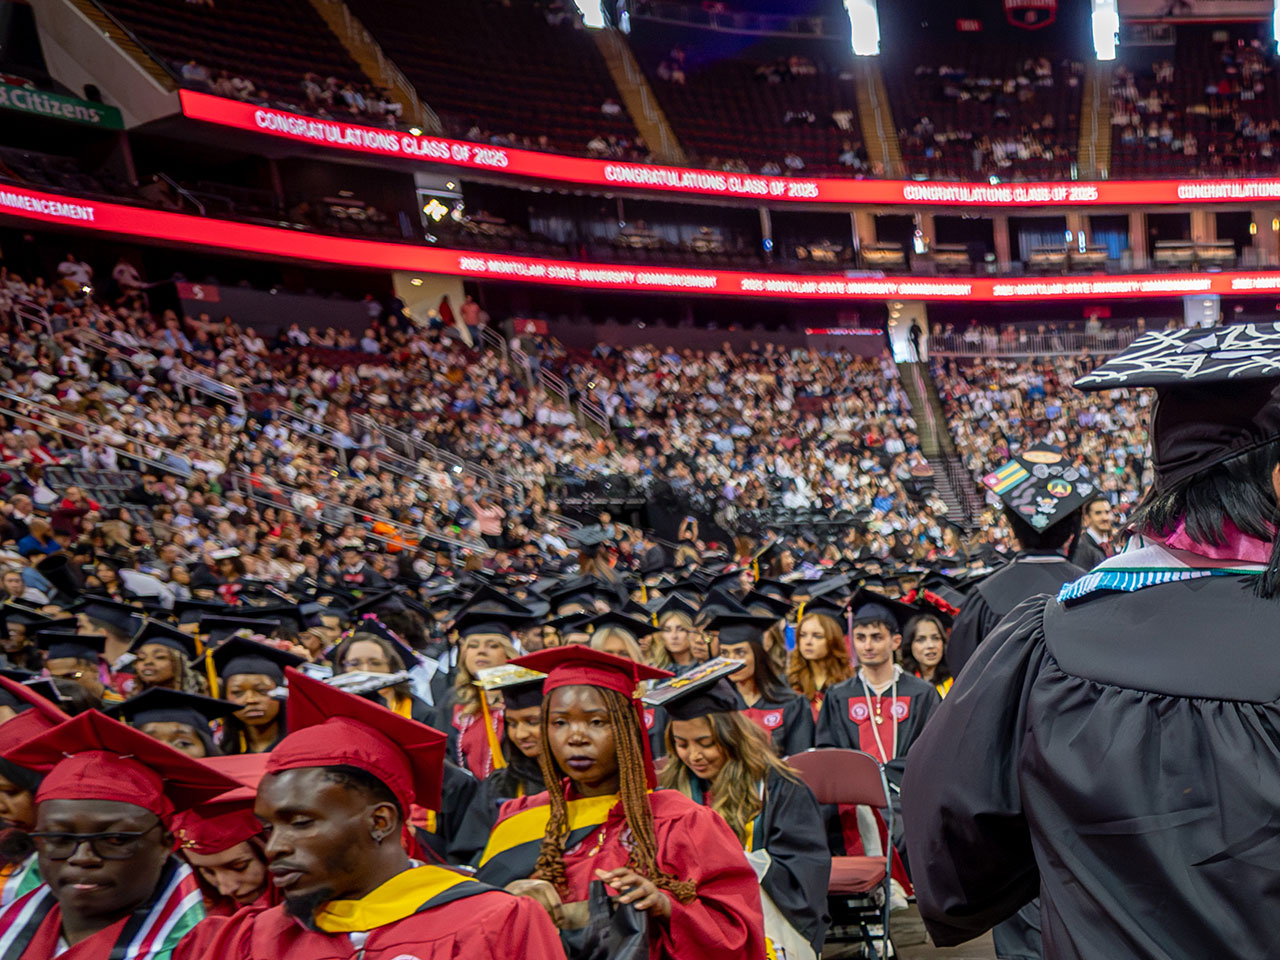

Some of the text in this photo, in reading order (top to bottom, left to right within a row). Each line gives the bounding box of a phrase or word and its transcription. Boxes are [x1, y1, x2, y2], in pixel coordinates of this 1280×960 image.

[11, 89, 100, 122] Citizens
[254, 110, 508, 168] CONGRATULATIONS CLASS OF 2025
[605, 165, 818, 198] CONGRATULATIONS CLASS OF 2025
[904, 186, 1098, 202] CONGRATULATIONS CLASS OF 2025
[460, 257, 717, 288] 2025 MONTCLAIR STATE UNIVERSITY COMMENCEMENT
